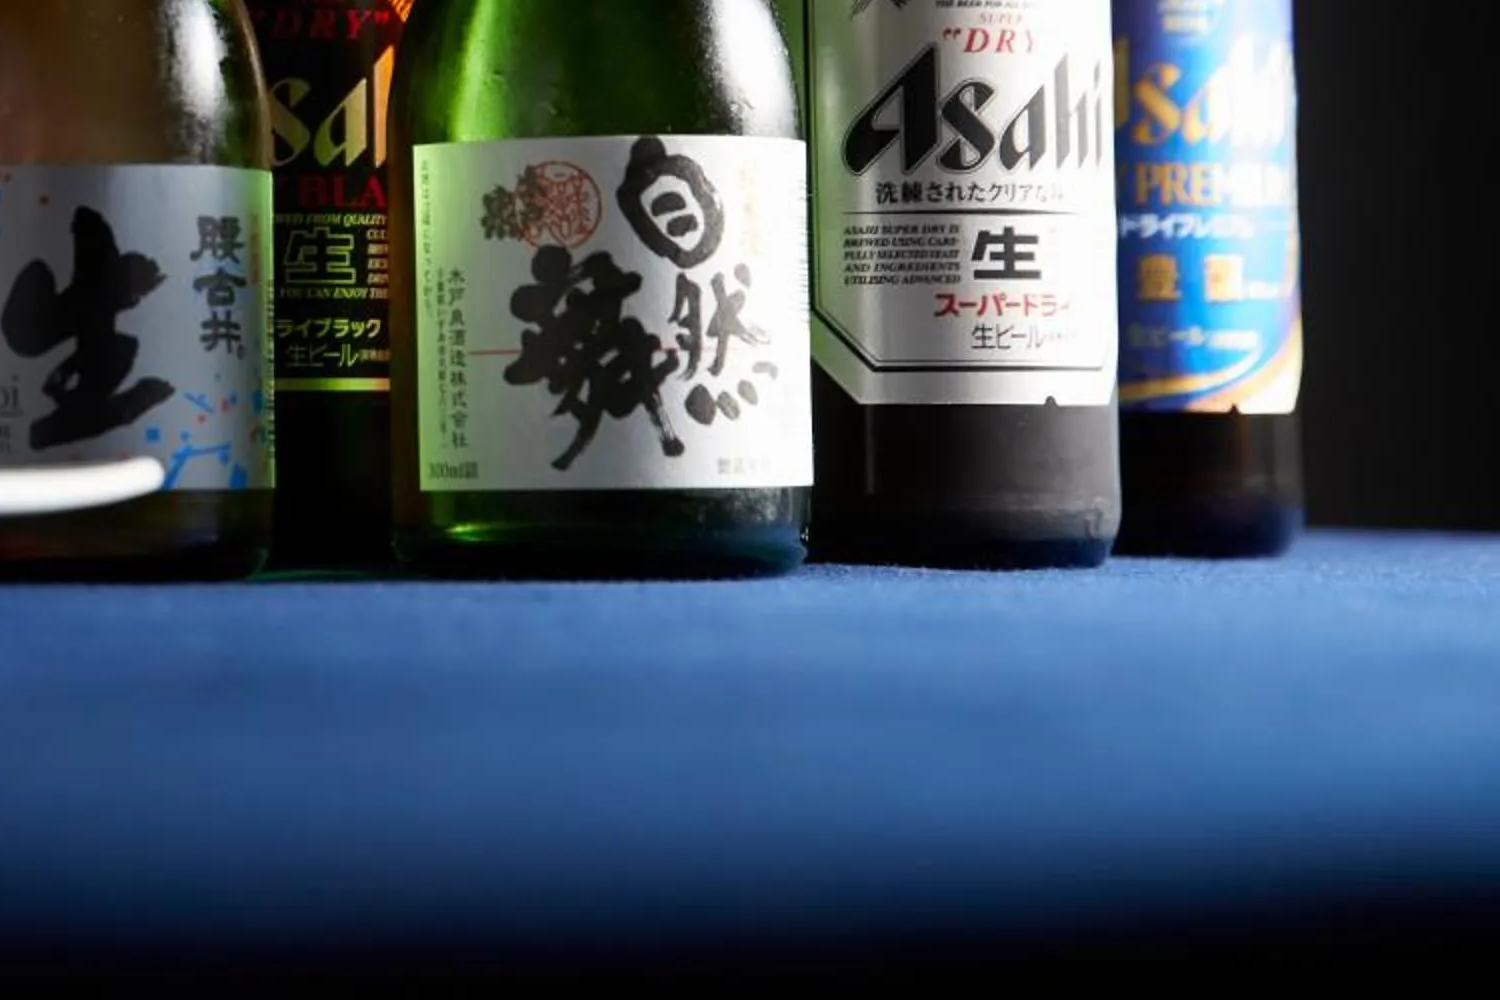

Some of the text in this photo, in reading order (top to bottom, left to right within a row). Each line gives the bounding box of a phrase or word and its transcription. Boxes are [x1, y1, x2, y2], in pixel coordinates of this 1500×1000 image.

[843, 43, 1104, 176] Asahi
[191, 216, 247, 360] 腰古井
[283, 226, 357, 285] 生
[971, 227, 1042, 280] 生
[1, 206, 176, 451] 生
[276, 318, 382, 338] ライブラック
